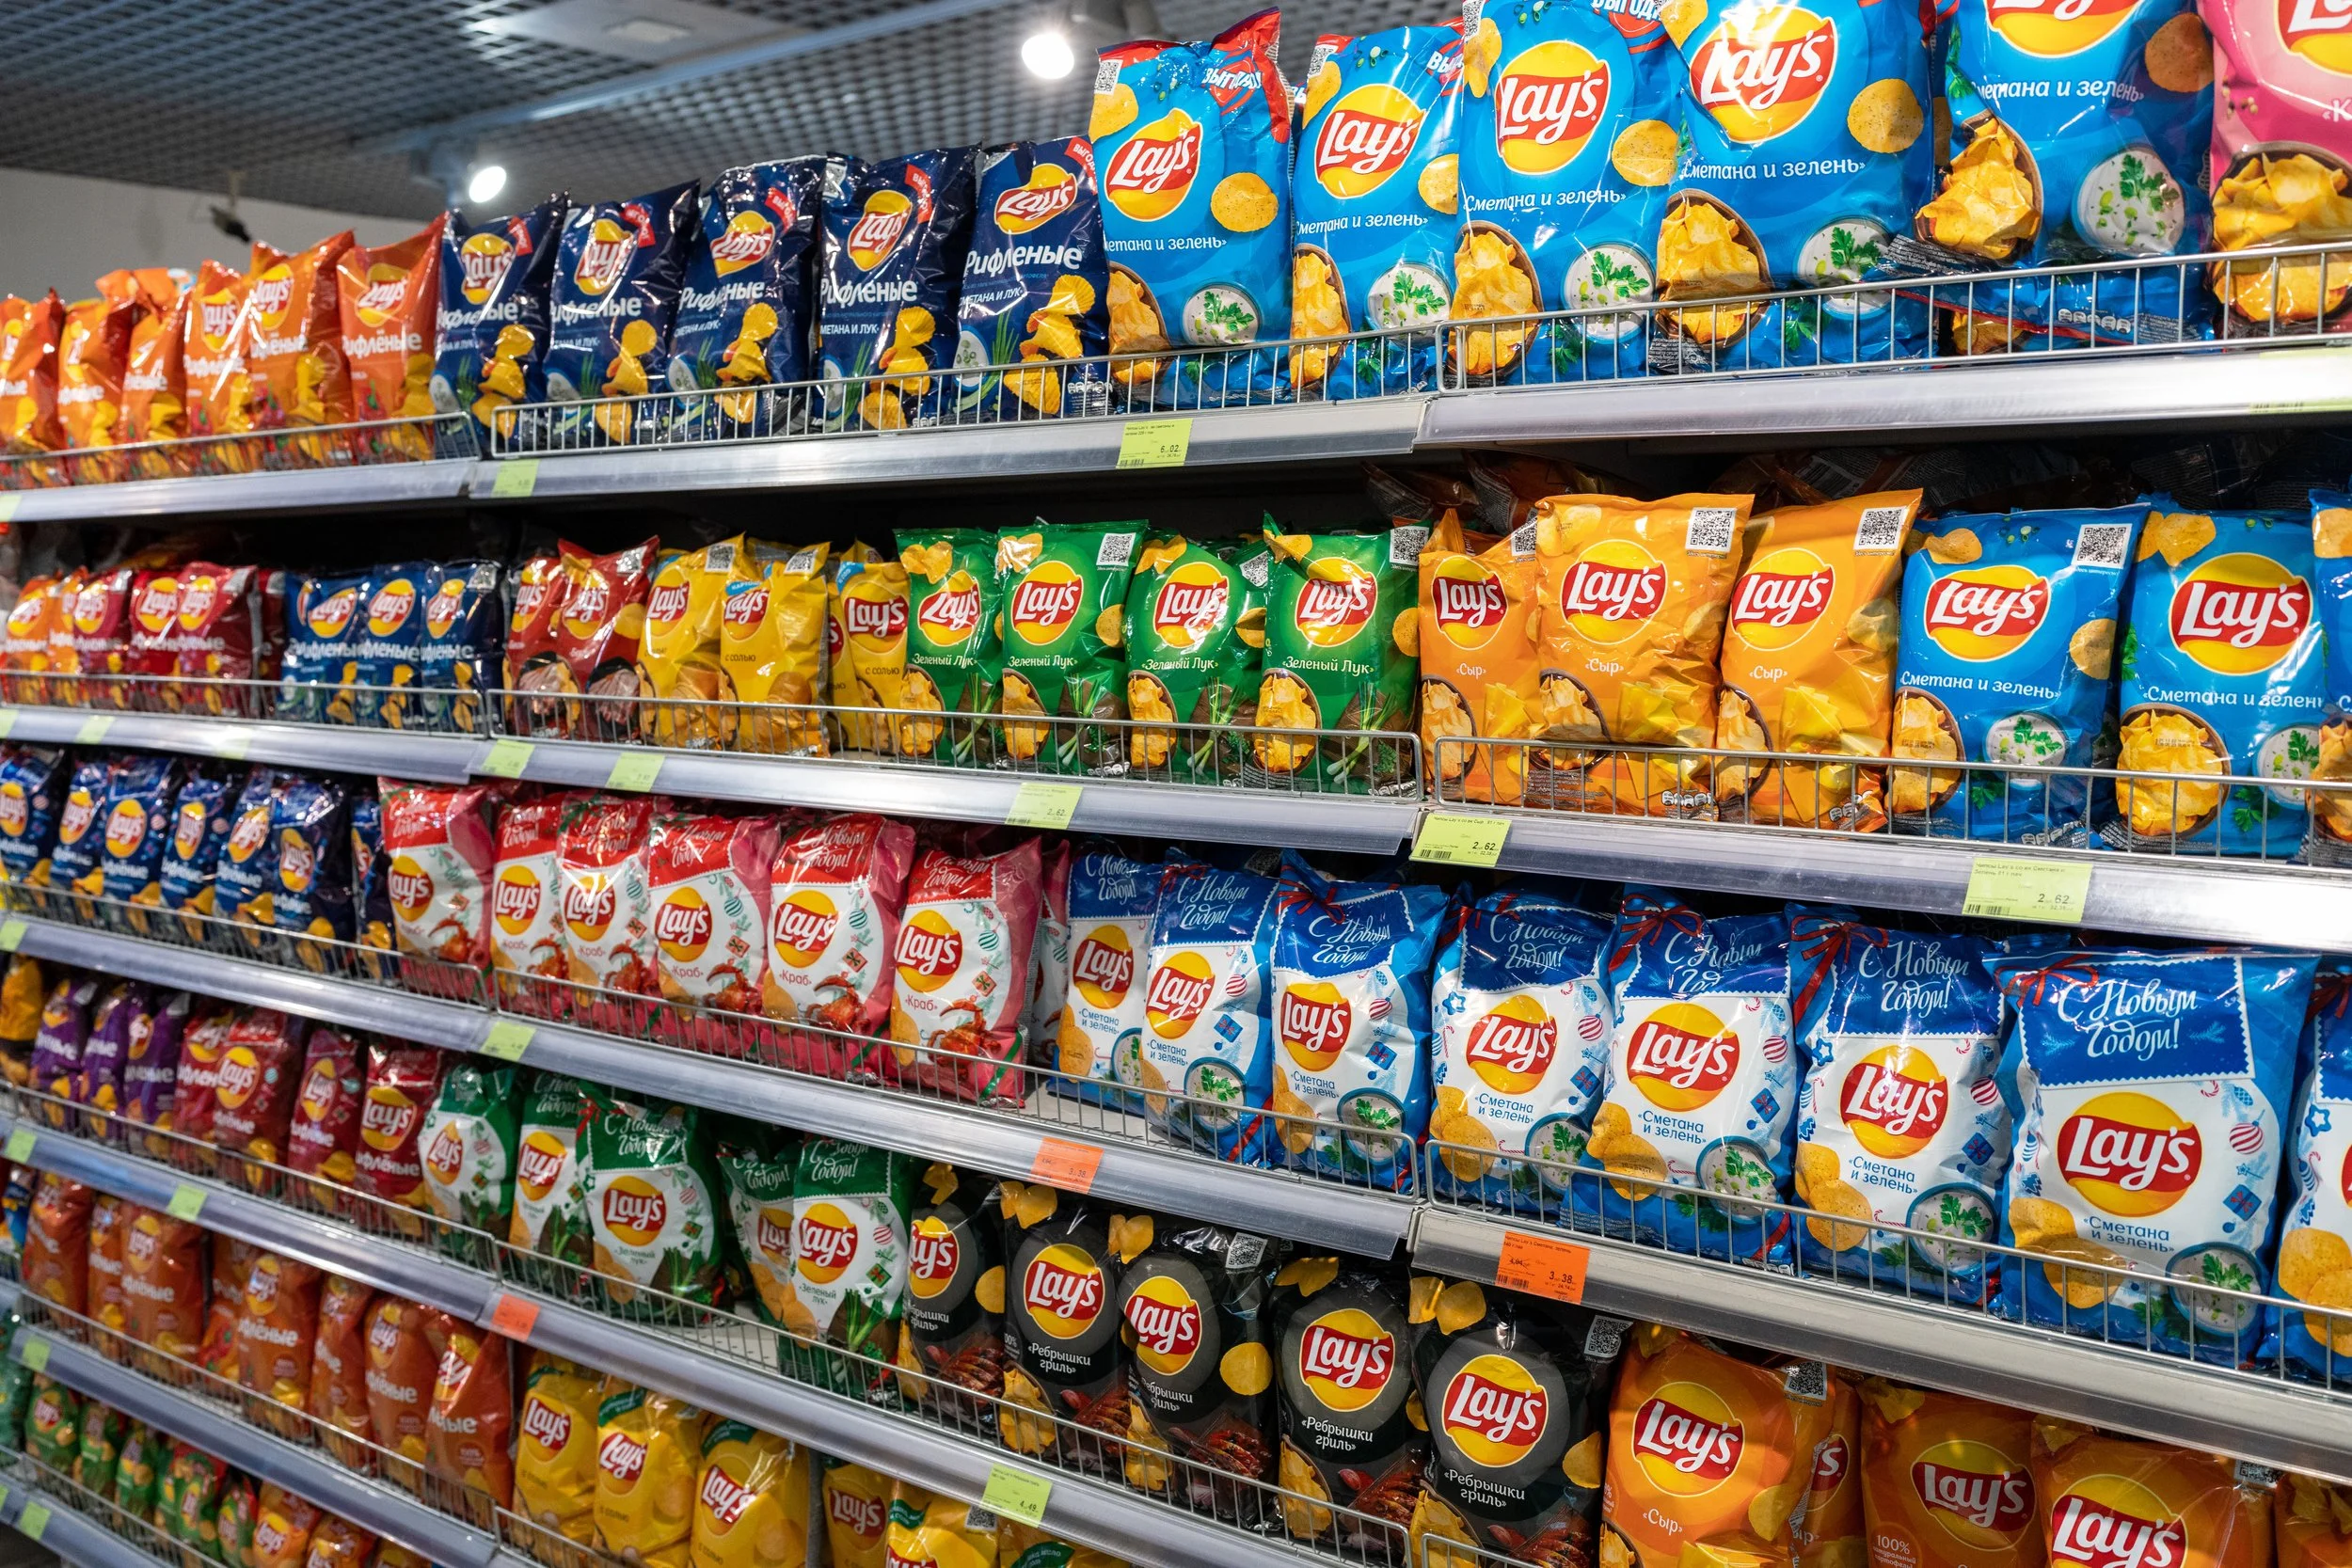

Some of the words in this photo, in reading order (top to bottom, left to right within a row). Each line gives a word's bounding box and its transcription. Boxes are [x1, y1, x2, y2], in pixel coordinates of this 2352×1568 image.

[1700, 31, 1826, 110] Lay's
[2057, 82, 2071, 96] и
[1499, 71, 1603, 145] Lay's
[1111, 133, 1196, 194] Lay's
[1319, 111, 1419, 174] Lay's
[1764, 165, 1777, 178] и
[1783, 159, 1866, 179] зелень»
[997, 184, 1072, 221] Lay's
[1353, 216, 1361, 227] и
[1365, 214, 1428, 228] зелень»
[1541, 194, 1551, 206] и
[1558, 189, 1626, 208] зелень»
[1152, 240, 1164, 250] и
[1168, 237, 1227, 249] зелень»
[648, 586, 689, 623] Lay's
[723, 590, 770, 626] Lay's
[921, 587, 980, 631] Lay's
[1015, 580, 1080, 626] Lay's
[1157, 583, 1227, 628] Lay's
[1301, 577, 1372, 626] Lay's
[1439, 578, 1502, 629] Lay's
[1566, 563, 1662, 621] Lay's
[1734, 570, 1829, 627] Lay's
[1931, 577, 2044, 637] Lay's
[2178, 582, 2304, 648] Lay's
[848, 597, 908, 638] Lay's
[1978, 677, 1988, 689] и
[2244, 691, 2254, 705] и
[495, 873, 538, 920] Lay's
[566, 884, 611, 927] Lay's
[2038, 894, 2045, 903] 2
[2055, 895, 2070, 904] 62
[659, 902, 708, 946] Lay's
[776, 902, 836, 952] Lay's
[896, 926, 959, 976] Lay's
[1077, 939, 1132, 992] Lay's
[1149, 966, 1214, 1021] Lay's
[1282, 992, 1349, 1052] Lay's
[1470, 1014, 1556, 1074] Lay's
[1631, 1022, 1735, 1089] Lay's
[364, 1098, 415, 1136] Lay's
[1478, 1105, 1486, 1116] и
[1845, 1066, 1941, 1135] Lay's
[1644, 1124, 1652, 1134] и
[1851, 1168, 1859, 1180] и
[2064, 1117, 2196, 1192] Lay's
[606, 1187, 661, 1230] Lay's
[801, 1216, 853, 1268] Lay's
[2091, 1229, 2102, 1241] и
[1029, 1261, 1100, 1319] Lay's
[1562, 1274, 1572, 1284] 38
[1305, 1327, 1391, 1388] Lay's
[524, 1398, 570, 1448] Lay's
[1300, 1416, 1374, 1443] «Ребрышки
[1448, 1374, 1542, 1443] Lay's
[600, 1432, 646, 1481] Lay's
[1315, 1433, 1357, 1452] гриль»
[1637, 1401, 1739, 1473] Lay's
[1443, 1468, 1526, 1501] «Ребрышки
[1459, 1487, 1507, 1508] гриль»
[1923, 1463, 2027, 1528] Lay's
[832, 1488, 882, 1534] Lay's
[2052, 1497, 2180, 1568] Lay's
[1876, 1534, 1911, 1555] 100%
